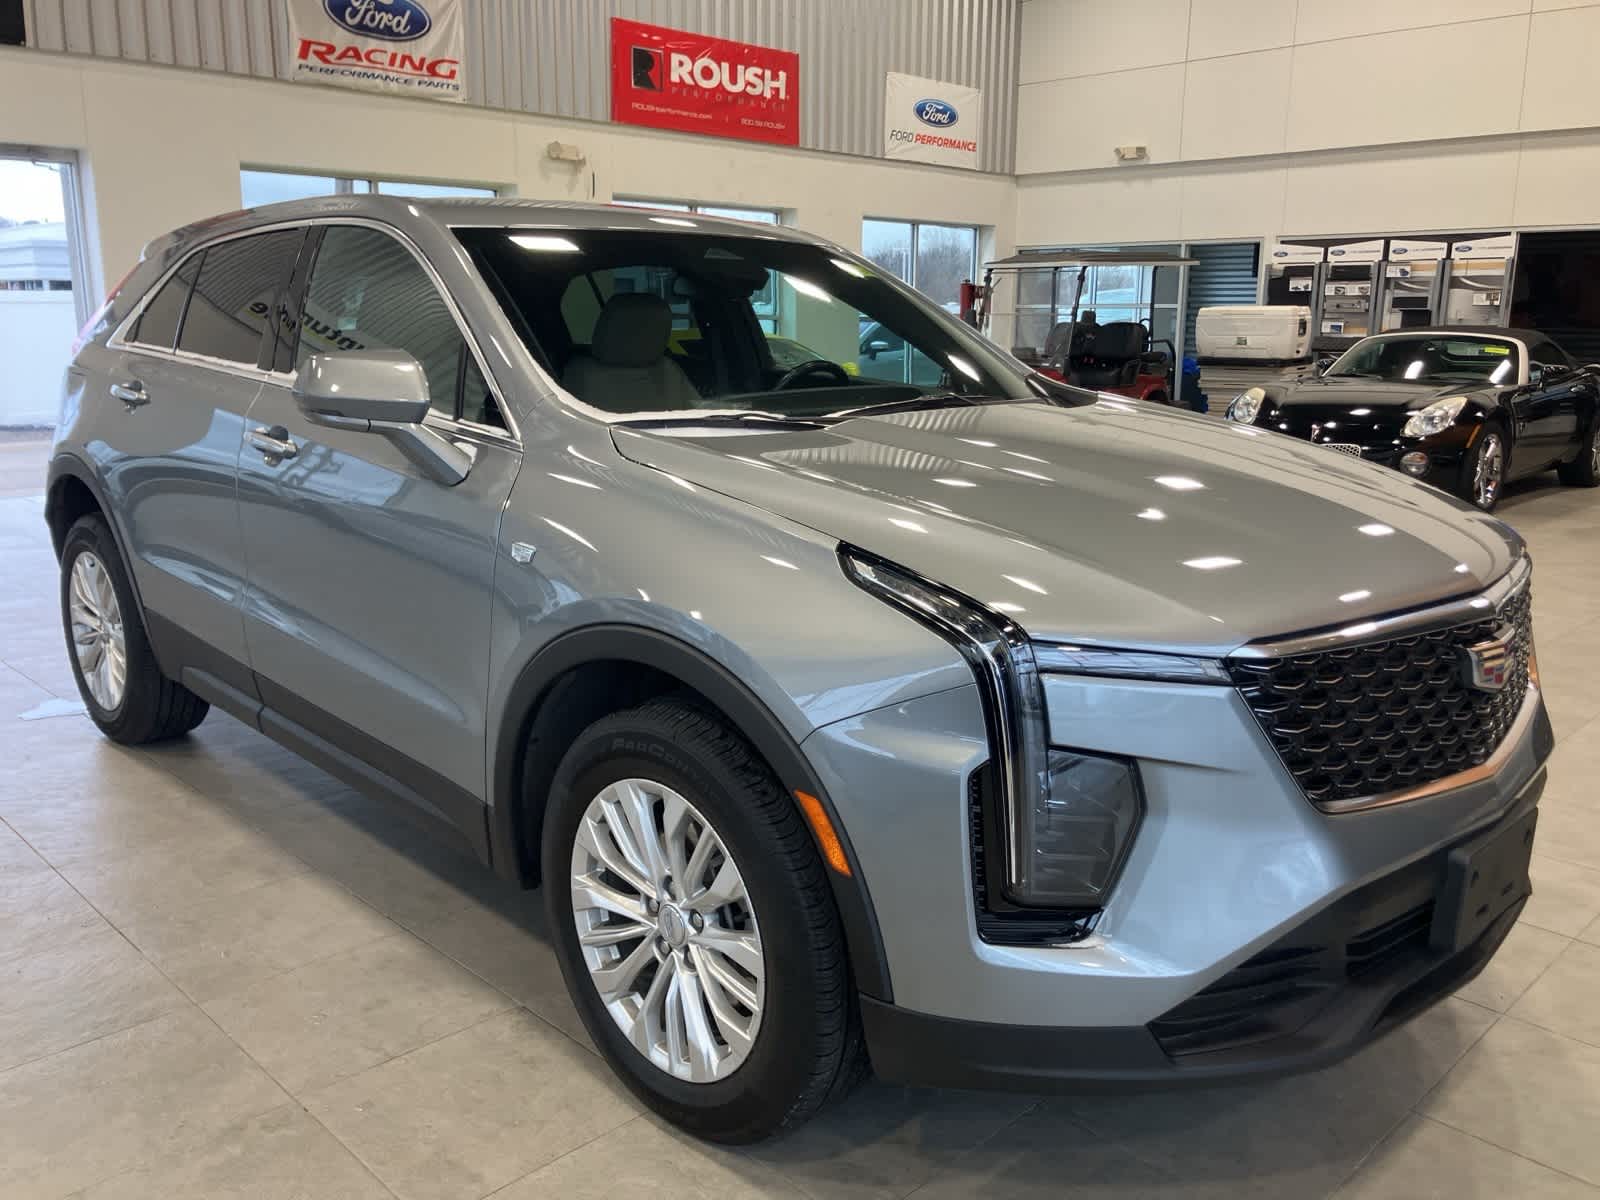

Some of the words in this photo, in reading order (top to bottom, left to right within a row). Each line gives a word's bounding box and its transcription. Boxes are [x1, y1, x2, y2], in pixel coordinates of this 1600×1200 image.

[345, 0, 411, 34] Ford
[298, 39, 460, 80] RACING
[298, 63, 414, 86] PERFORMANCE
[417, 79, 461, 91] PARTS
[670, 52, 787, 100] ROUSH
[922, 102, 950, 124] Ford
[889, 129, 914, 143] FORD
[914, 133, 977, 153] PERFORMANCE
